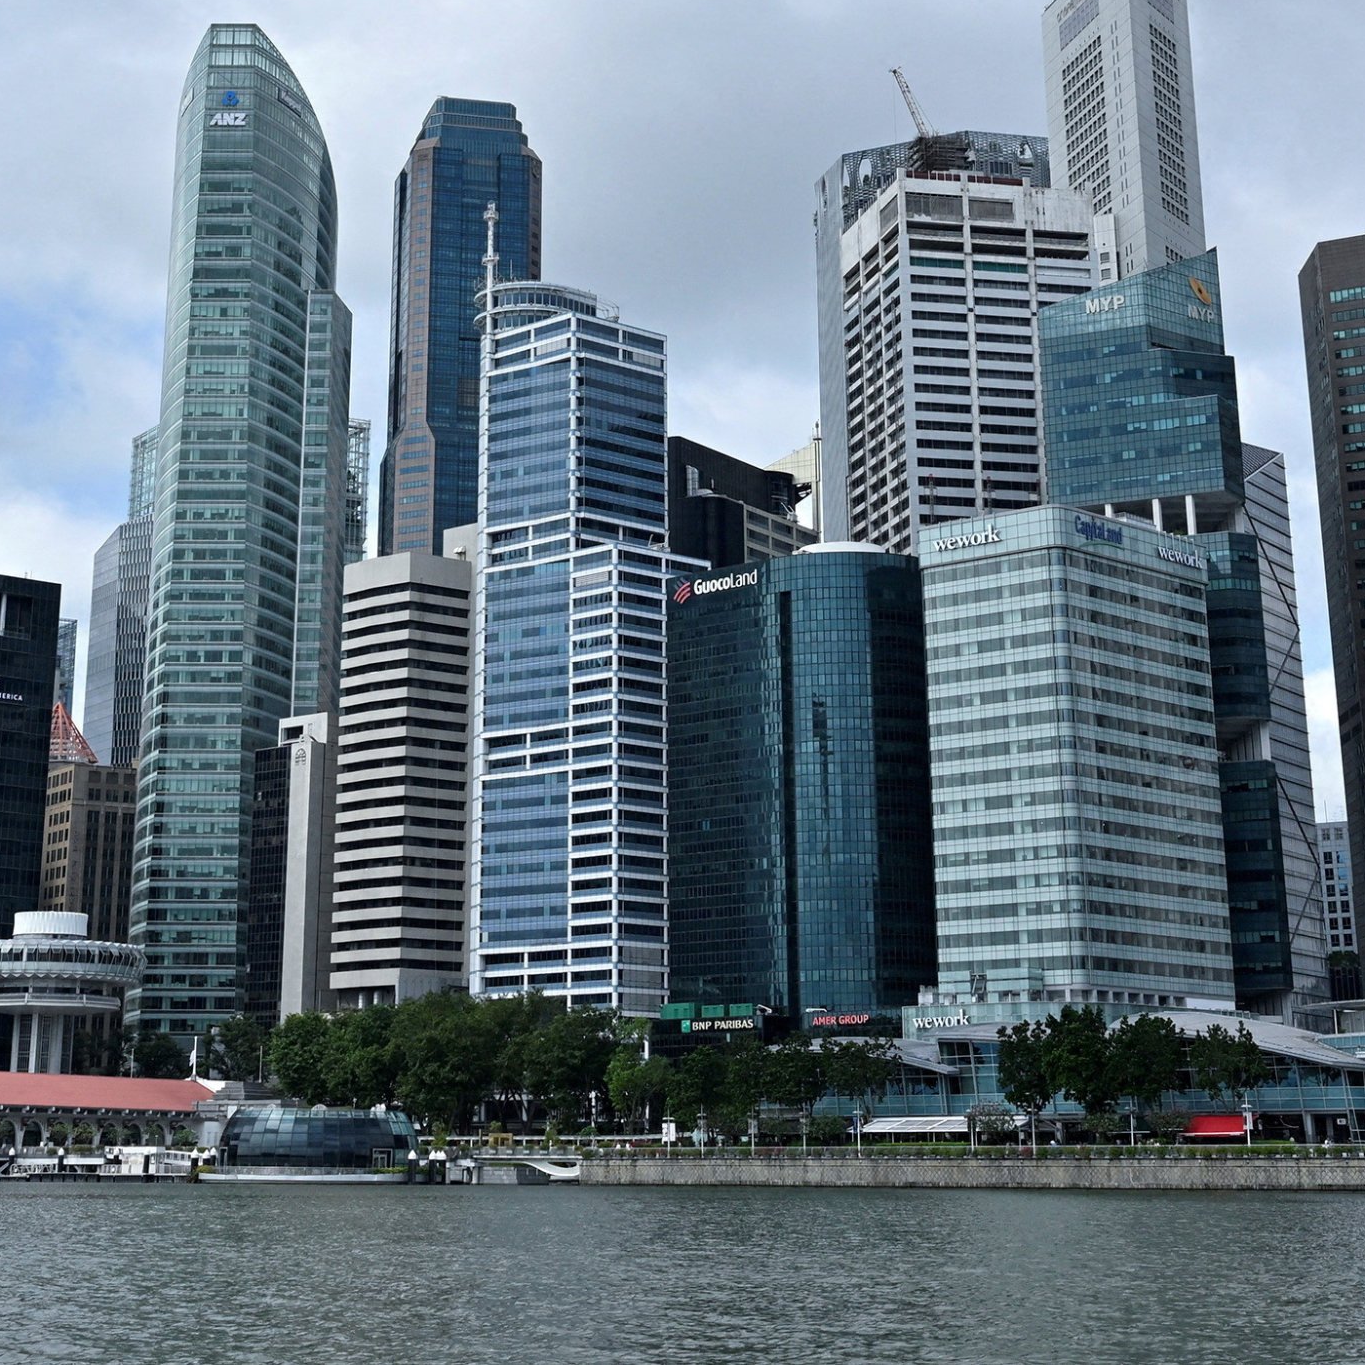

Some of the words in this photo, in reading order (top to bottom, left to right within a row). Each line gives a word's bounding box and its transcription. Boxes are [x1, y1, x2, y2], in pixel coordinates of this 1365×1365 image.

[209, 113, 246, 125] ANZ
[1085, 295, 1124, 314] MYP
[1188, 304, 1214, 323] MYP
[933, 523, 1001, 552] wework
[1075, 514, 1123, 545] CapitaLand
[1157, 546, 1203, 569] wework
[693, 568, 758, 595] GuocoLand
[692, 1020, 712, 1031] BNP
[714, 1019, 754, 1030] PARIBAS
[813, 1016, 837, 1026] AMER
[839, 1014, 869, 1025] GROUP
[913, 1008, 969, 1029] wework
